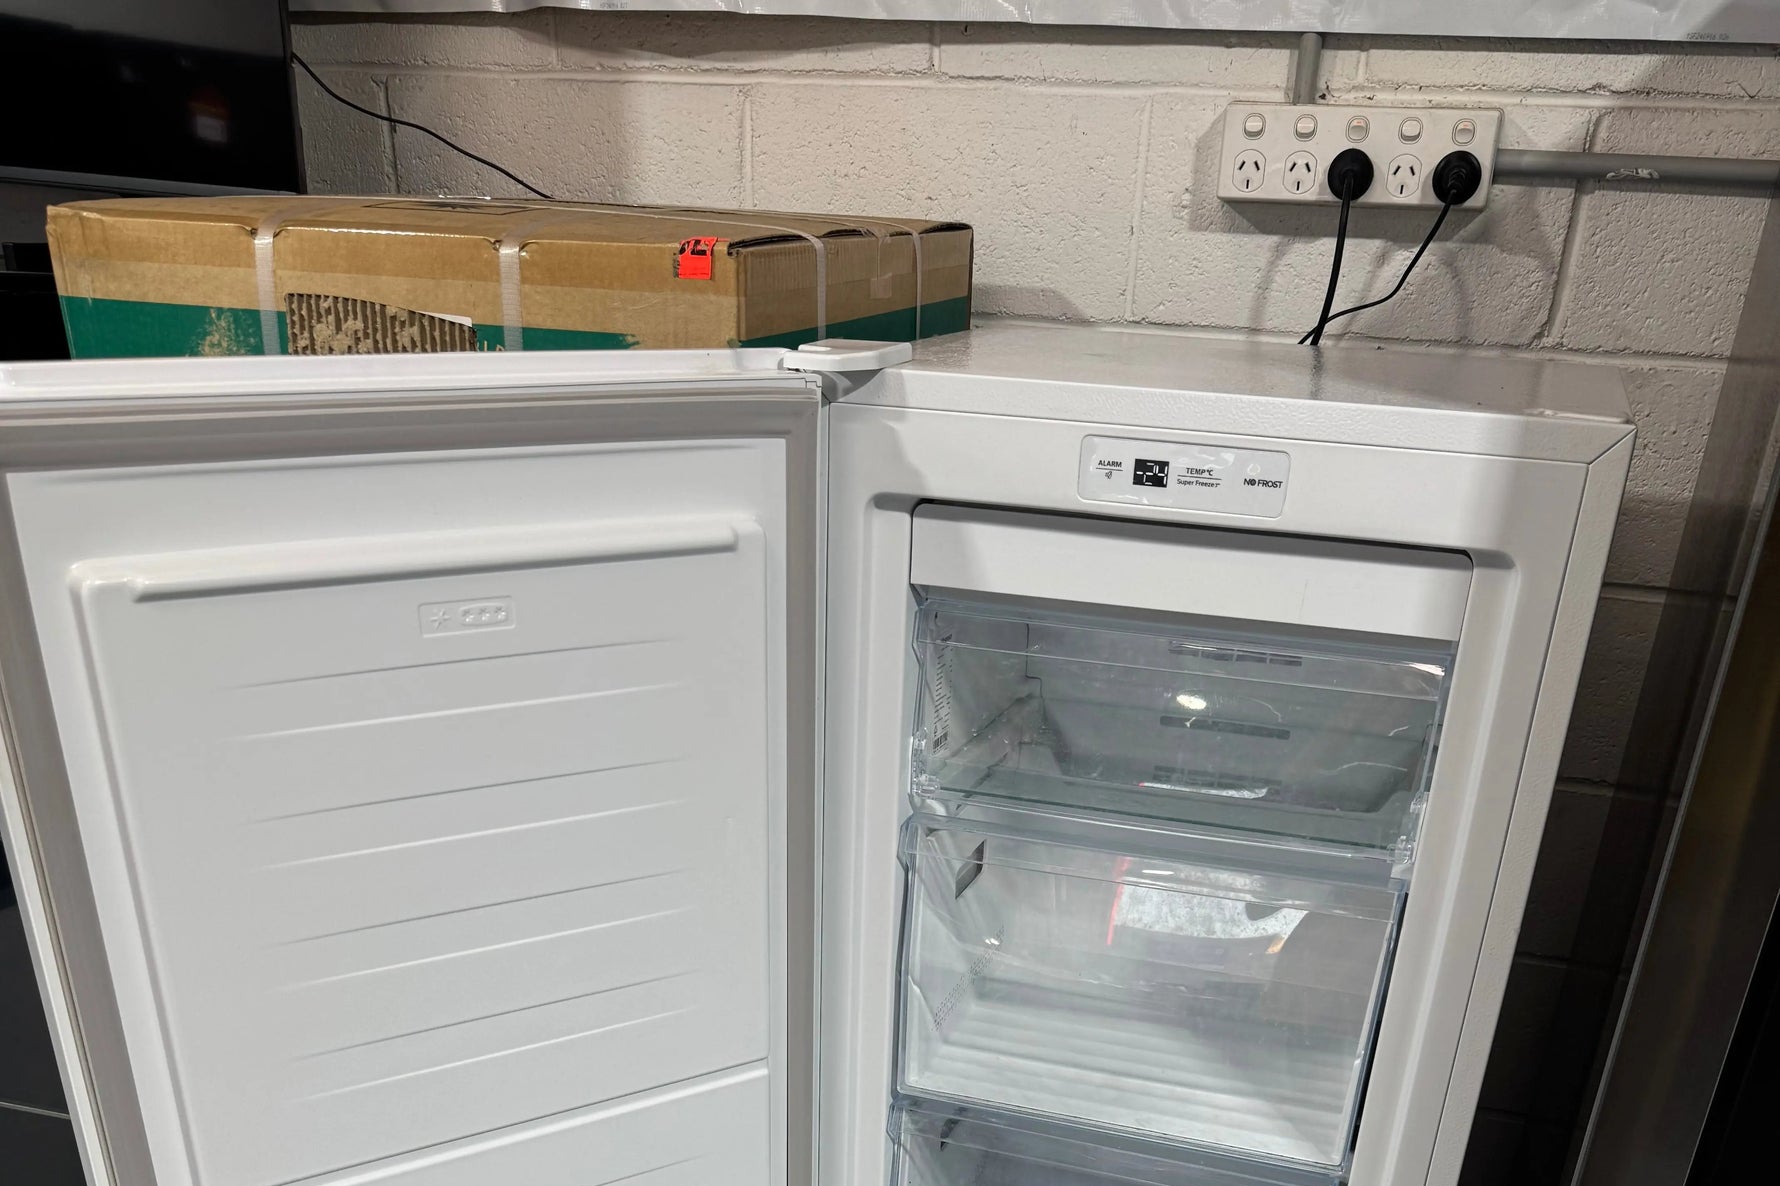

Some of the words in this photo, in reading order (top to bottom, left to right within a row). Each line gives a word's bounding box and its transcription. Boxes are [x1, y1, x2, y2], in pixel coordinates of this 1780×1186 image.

[1097, 459, 1123, 468] ALARM
[1176, 478, 1195, 487] Super
[1195, 479, 1215, 488] Freeze
[1257, 479, 1284, 489] FROST
